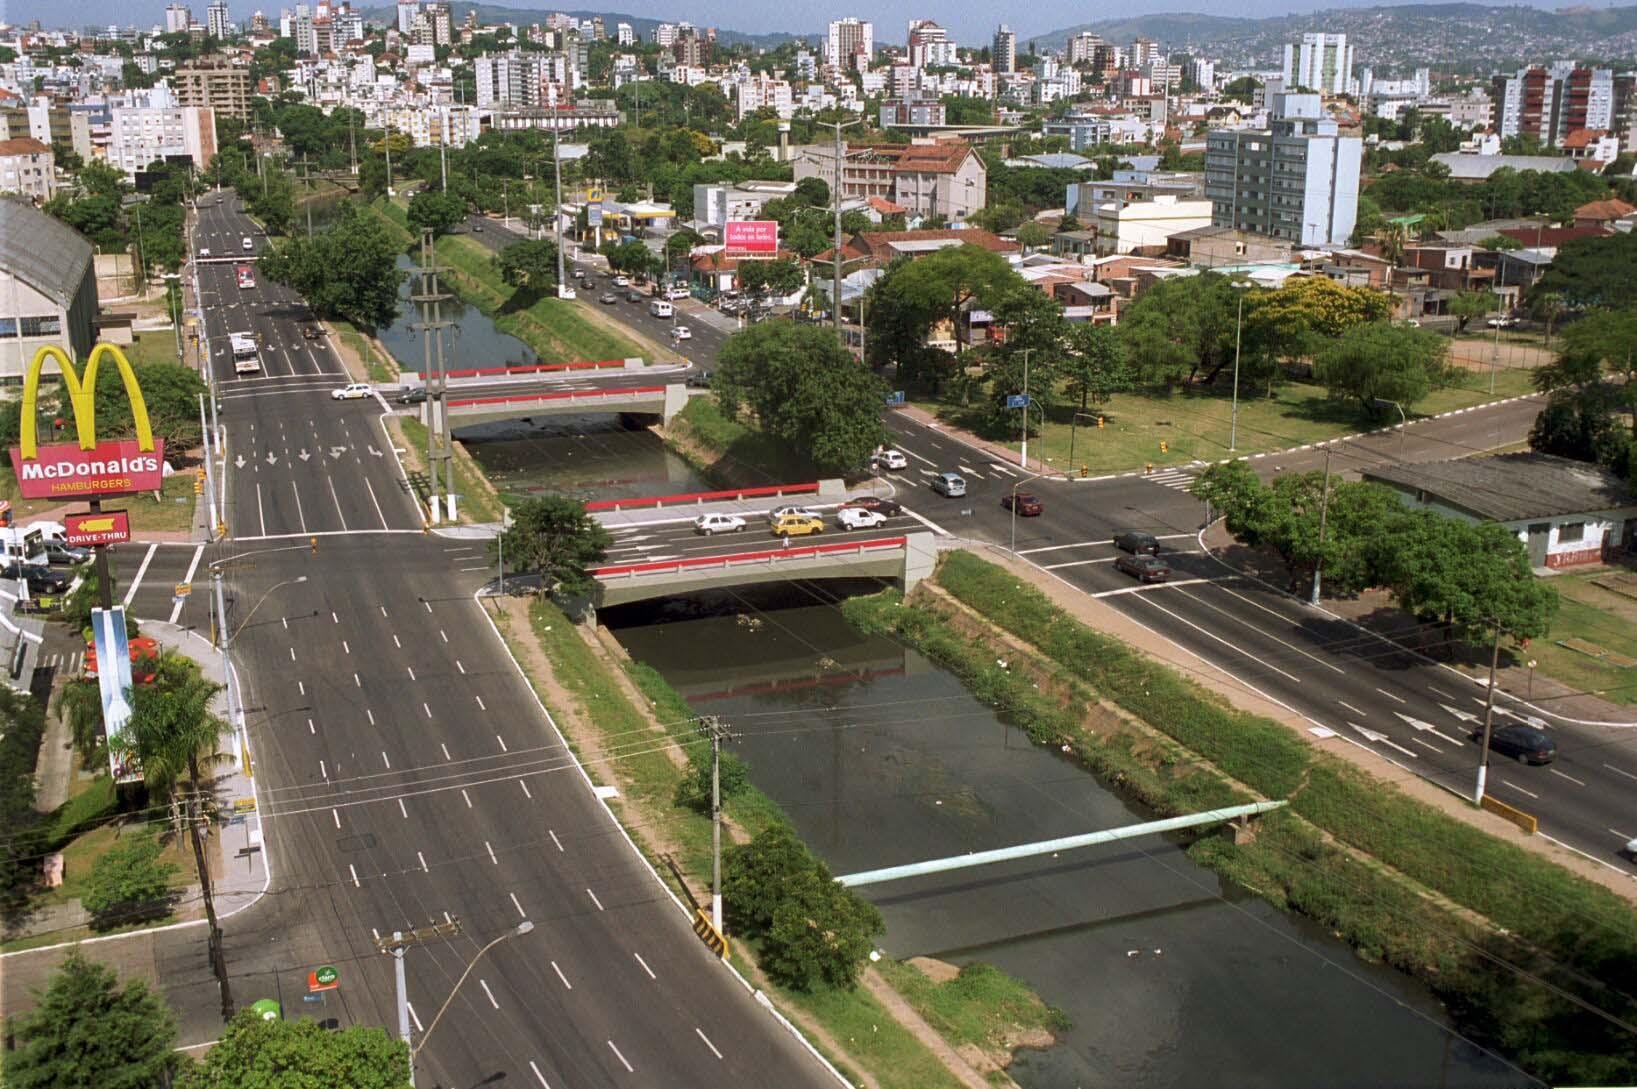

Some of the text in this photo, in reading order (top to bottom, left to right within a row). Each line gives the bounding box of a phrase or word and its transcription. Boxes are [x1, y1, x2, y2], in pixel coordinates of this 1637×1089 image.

[22, 456, 158, 480] McDonald's
[51, 478, 132, 492] HAMBURGERS
[318, 974, 336, 983] claro
